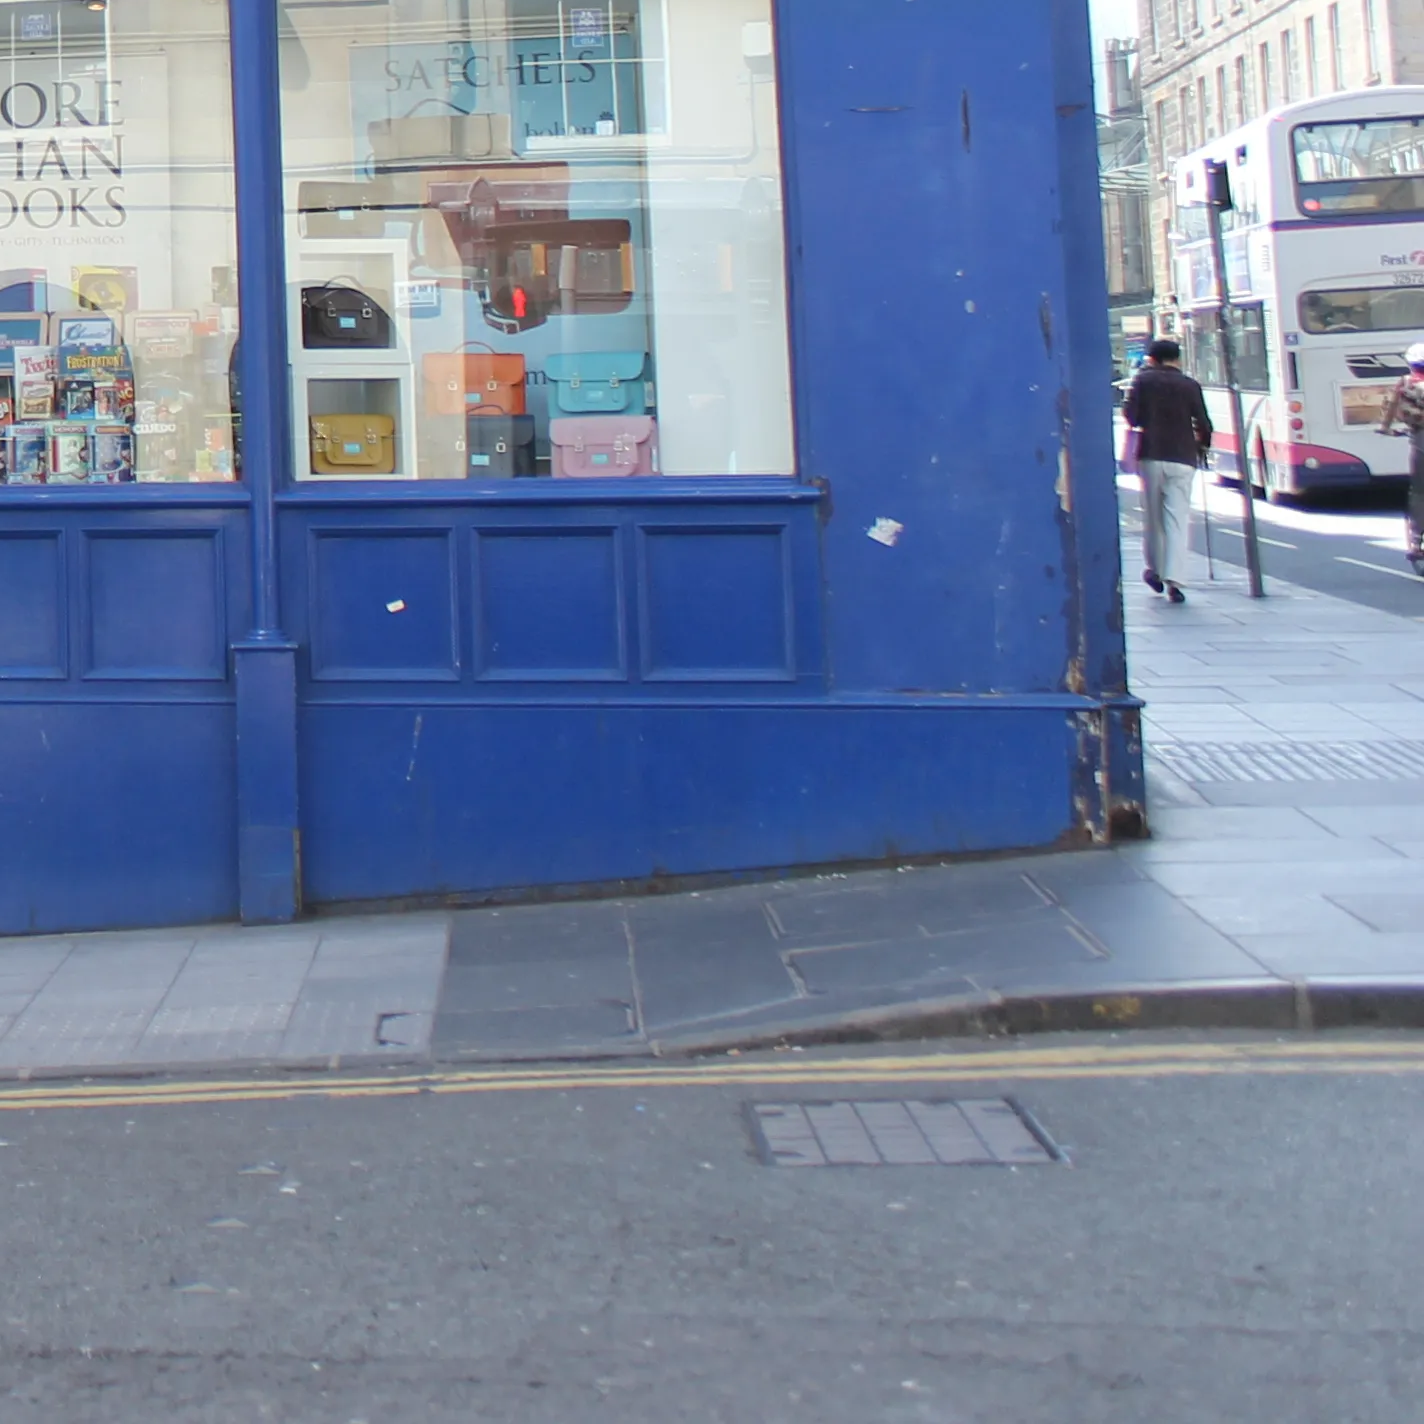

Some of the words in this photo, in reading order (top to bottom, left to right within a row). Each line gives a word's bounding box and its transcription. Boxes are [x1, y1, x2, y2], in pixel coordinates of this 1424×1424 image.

[384, 49, 597, 92] SATCHELS
[14, 236, 43, 247] GIFTS
[52, 235, 126, 246] TECHNOLOGY
[1380, 253, 1408, 266] First
